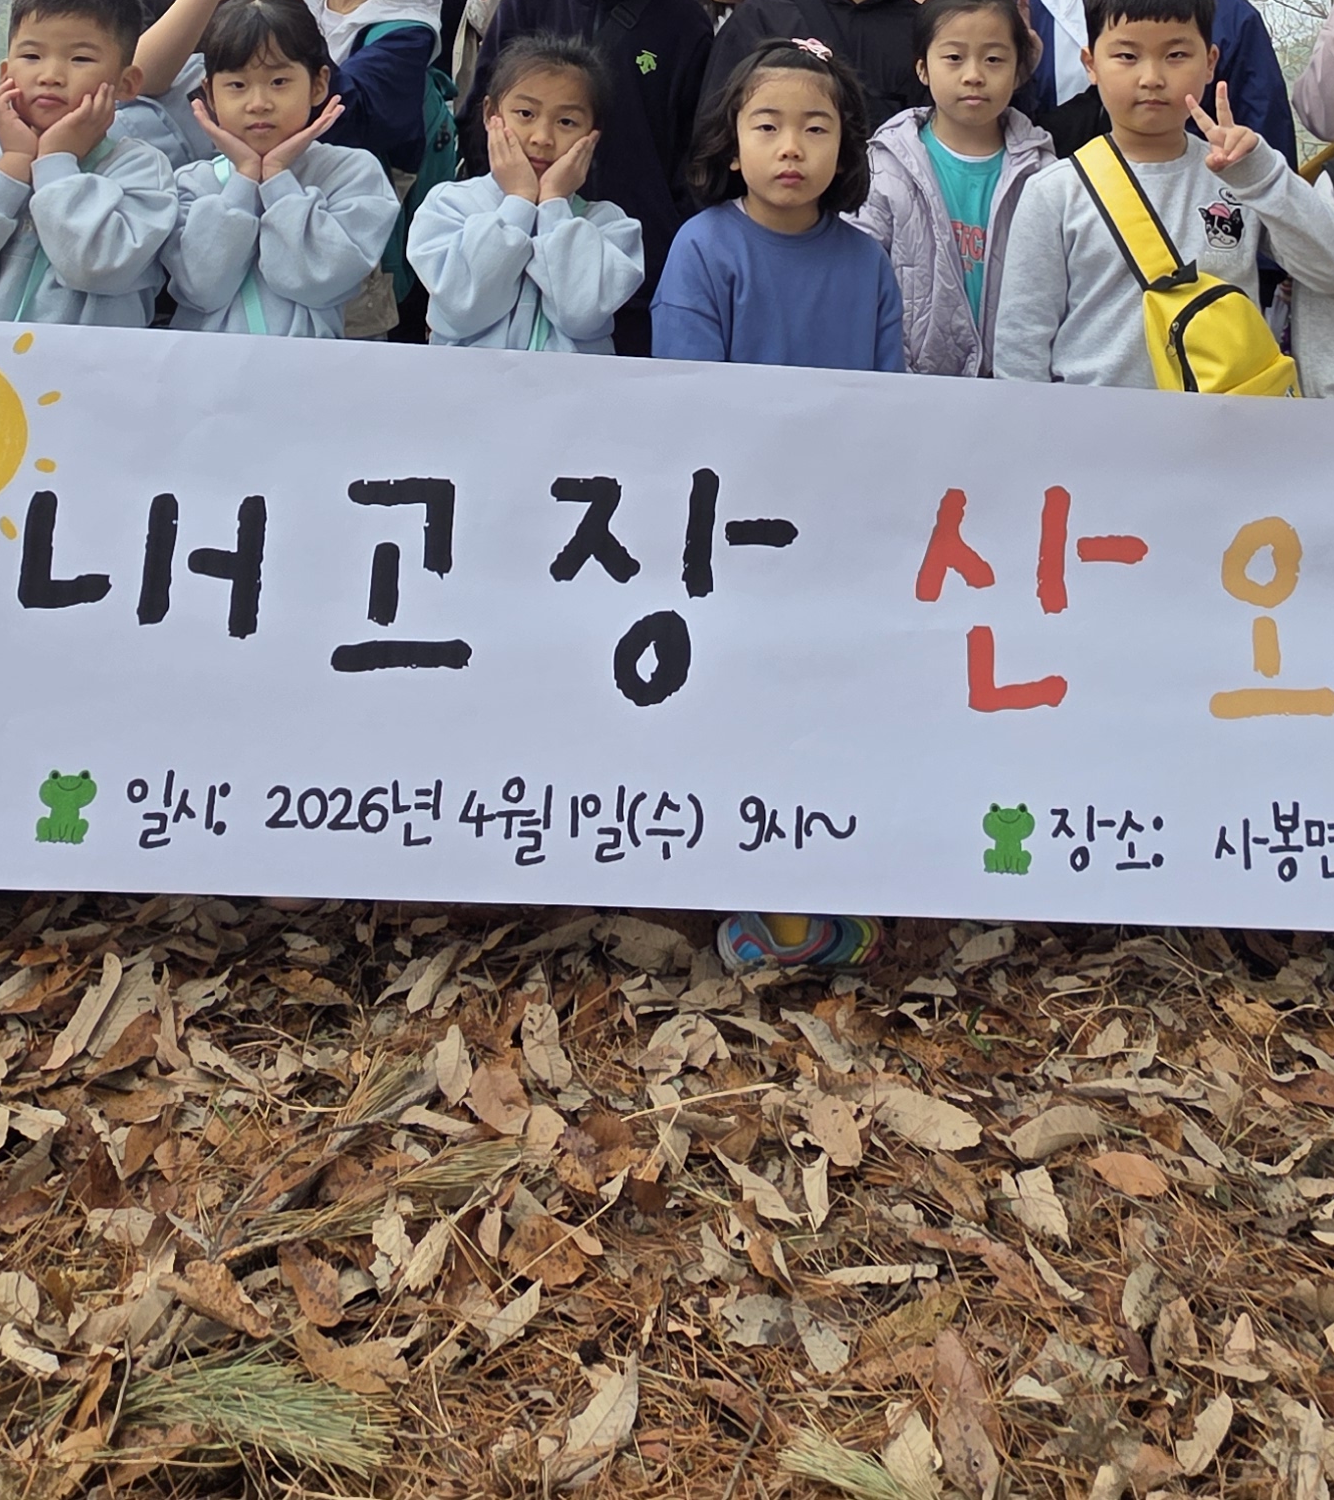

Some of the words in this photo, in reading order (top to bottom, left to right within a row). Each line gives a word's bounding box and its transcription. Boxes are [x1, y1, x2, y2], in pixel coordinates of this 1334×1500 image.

[126, 769, 231, 850] 일시:
[265, 779, 442, 847] 2026년
[1050, 804, 1164, 873] 장소:
